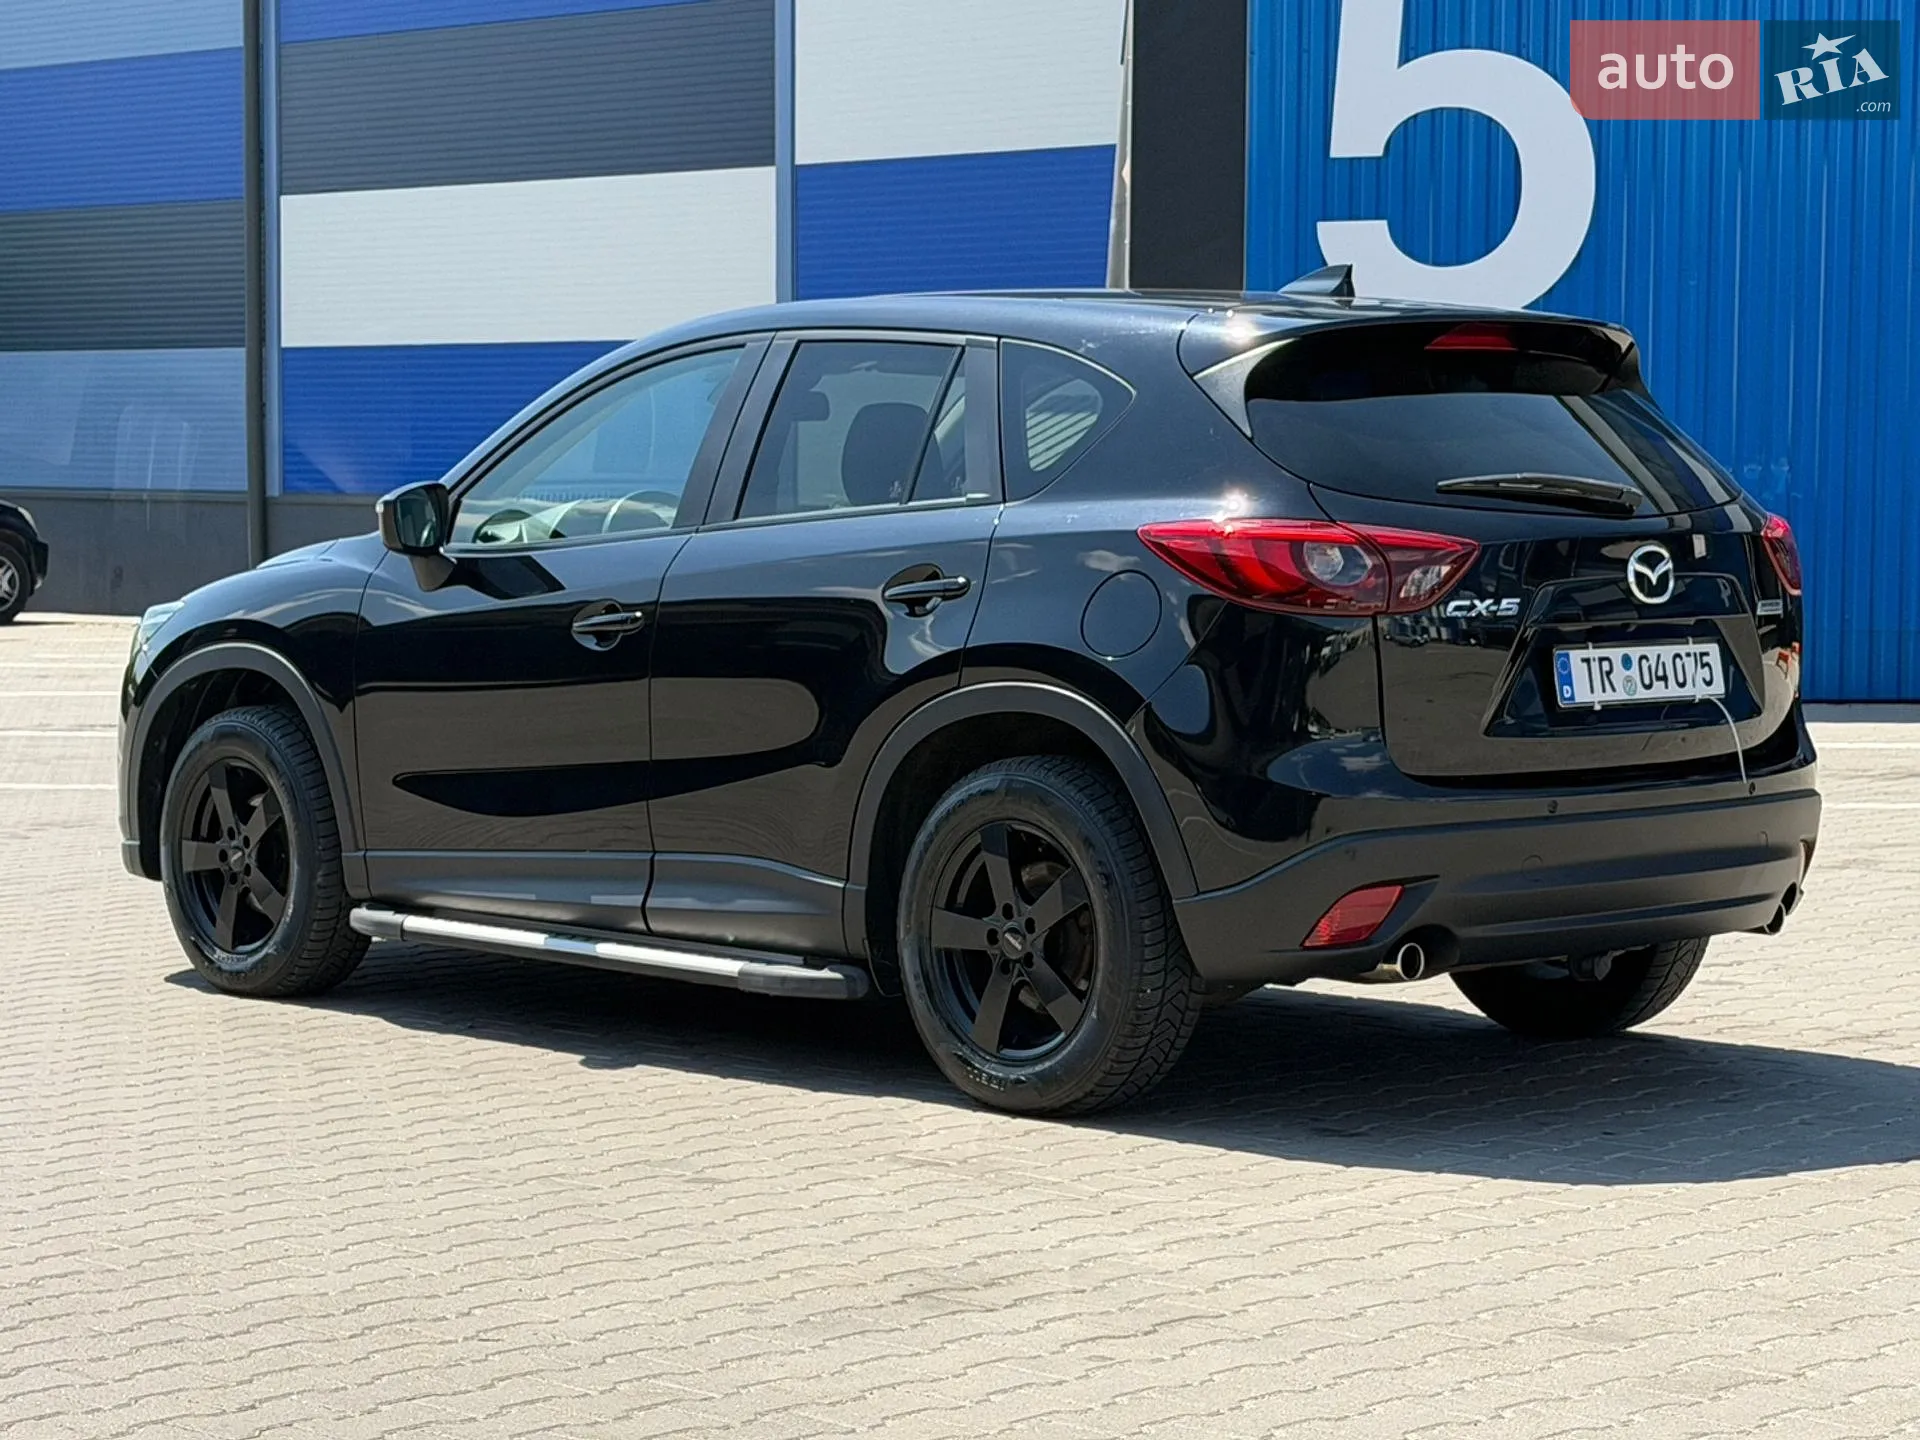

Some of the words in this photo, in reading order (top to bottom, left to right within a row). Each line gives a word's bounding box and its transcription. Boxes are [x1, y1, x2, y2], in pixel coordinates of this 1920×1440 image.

[1316, 0, 1596, 310] 5
[1446, 598, 1521, 617] CX-5
[1580, 656, 1617, 694] TR
